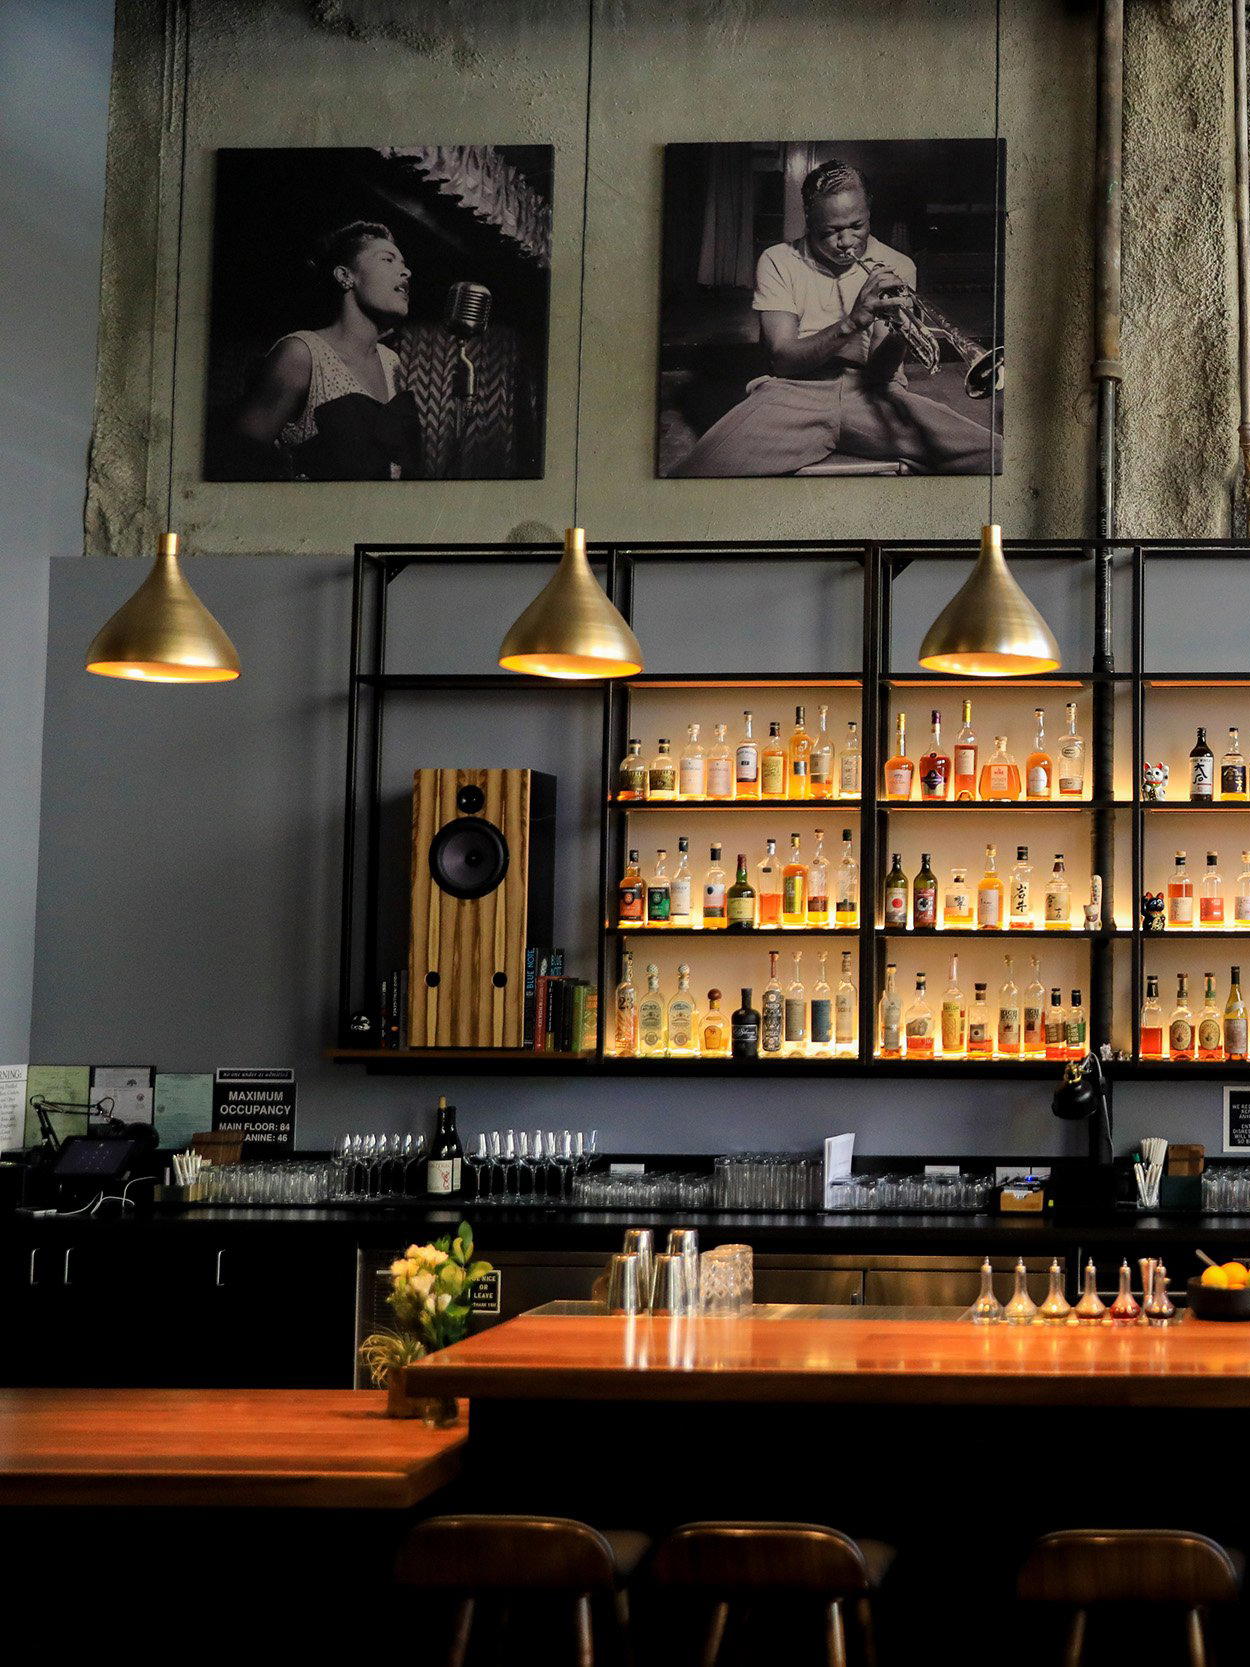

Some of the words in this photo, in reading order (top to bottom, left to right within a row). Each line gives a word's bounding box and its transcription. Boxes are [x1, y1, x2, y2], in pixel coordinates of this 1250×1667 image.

[228, 1091, 284, 1101] MAXIMUM
[220, 1104, 291, 1115] OCCUPANCY
[219, 1122, 242, 1130] MAIN
[244, 1122, 278, 1131] FLOOR:
[280, 1123, 290, 1131] 84
[277, 1134, 288, 1142] 46
